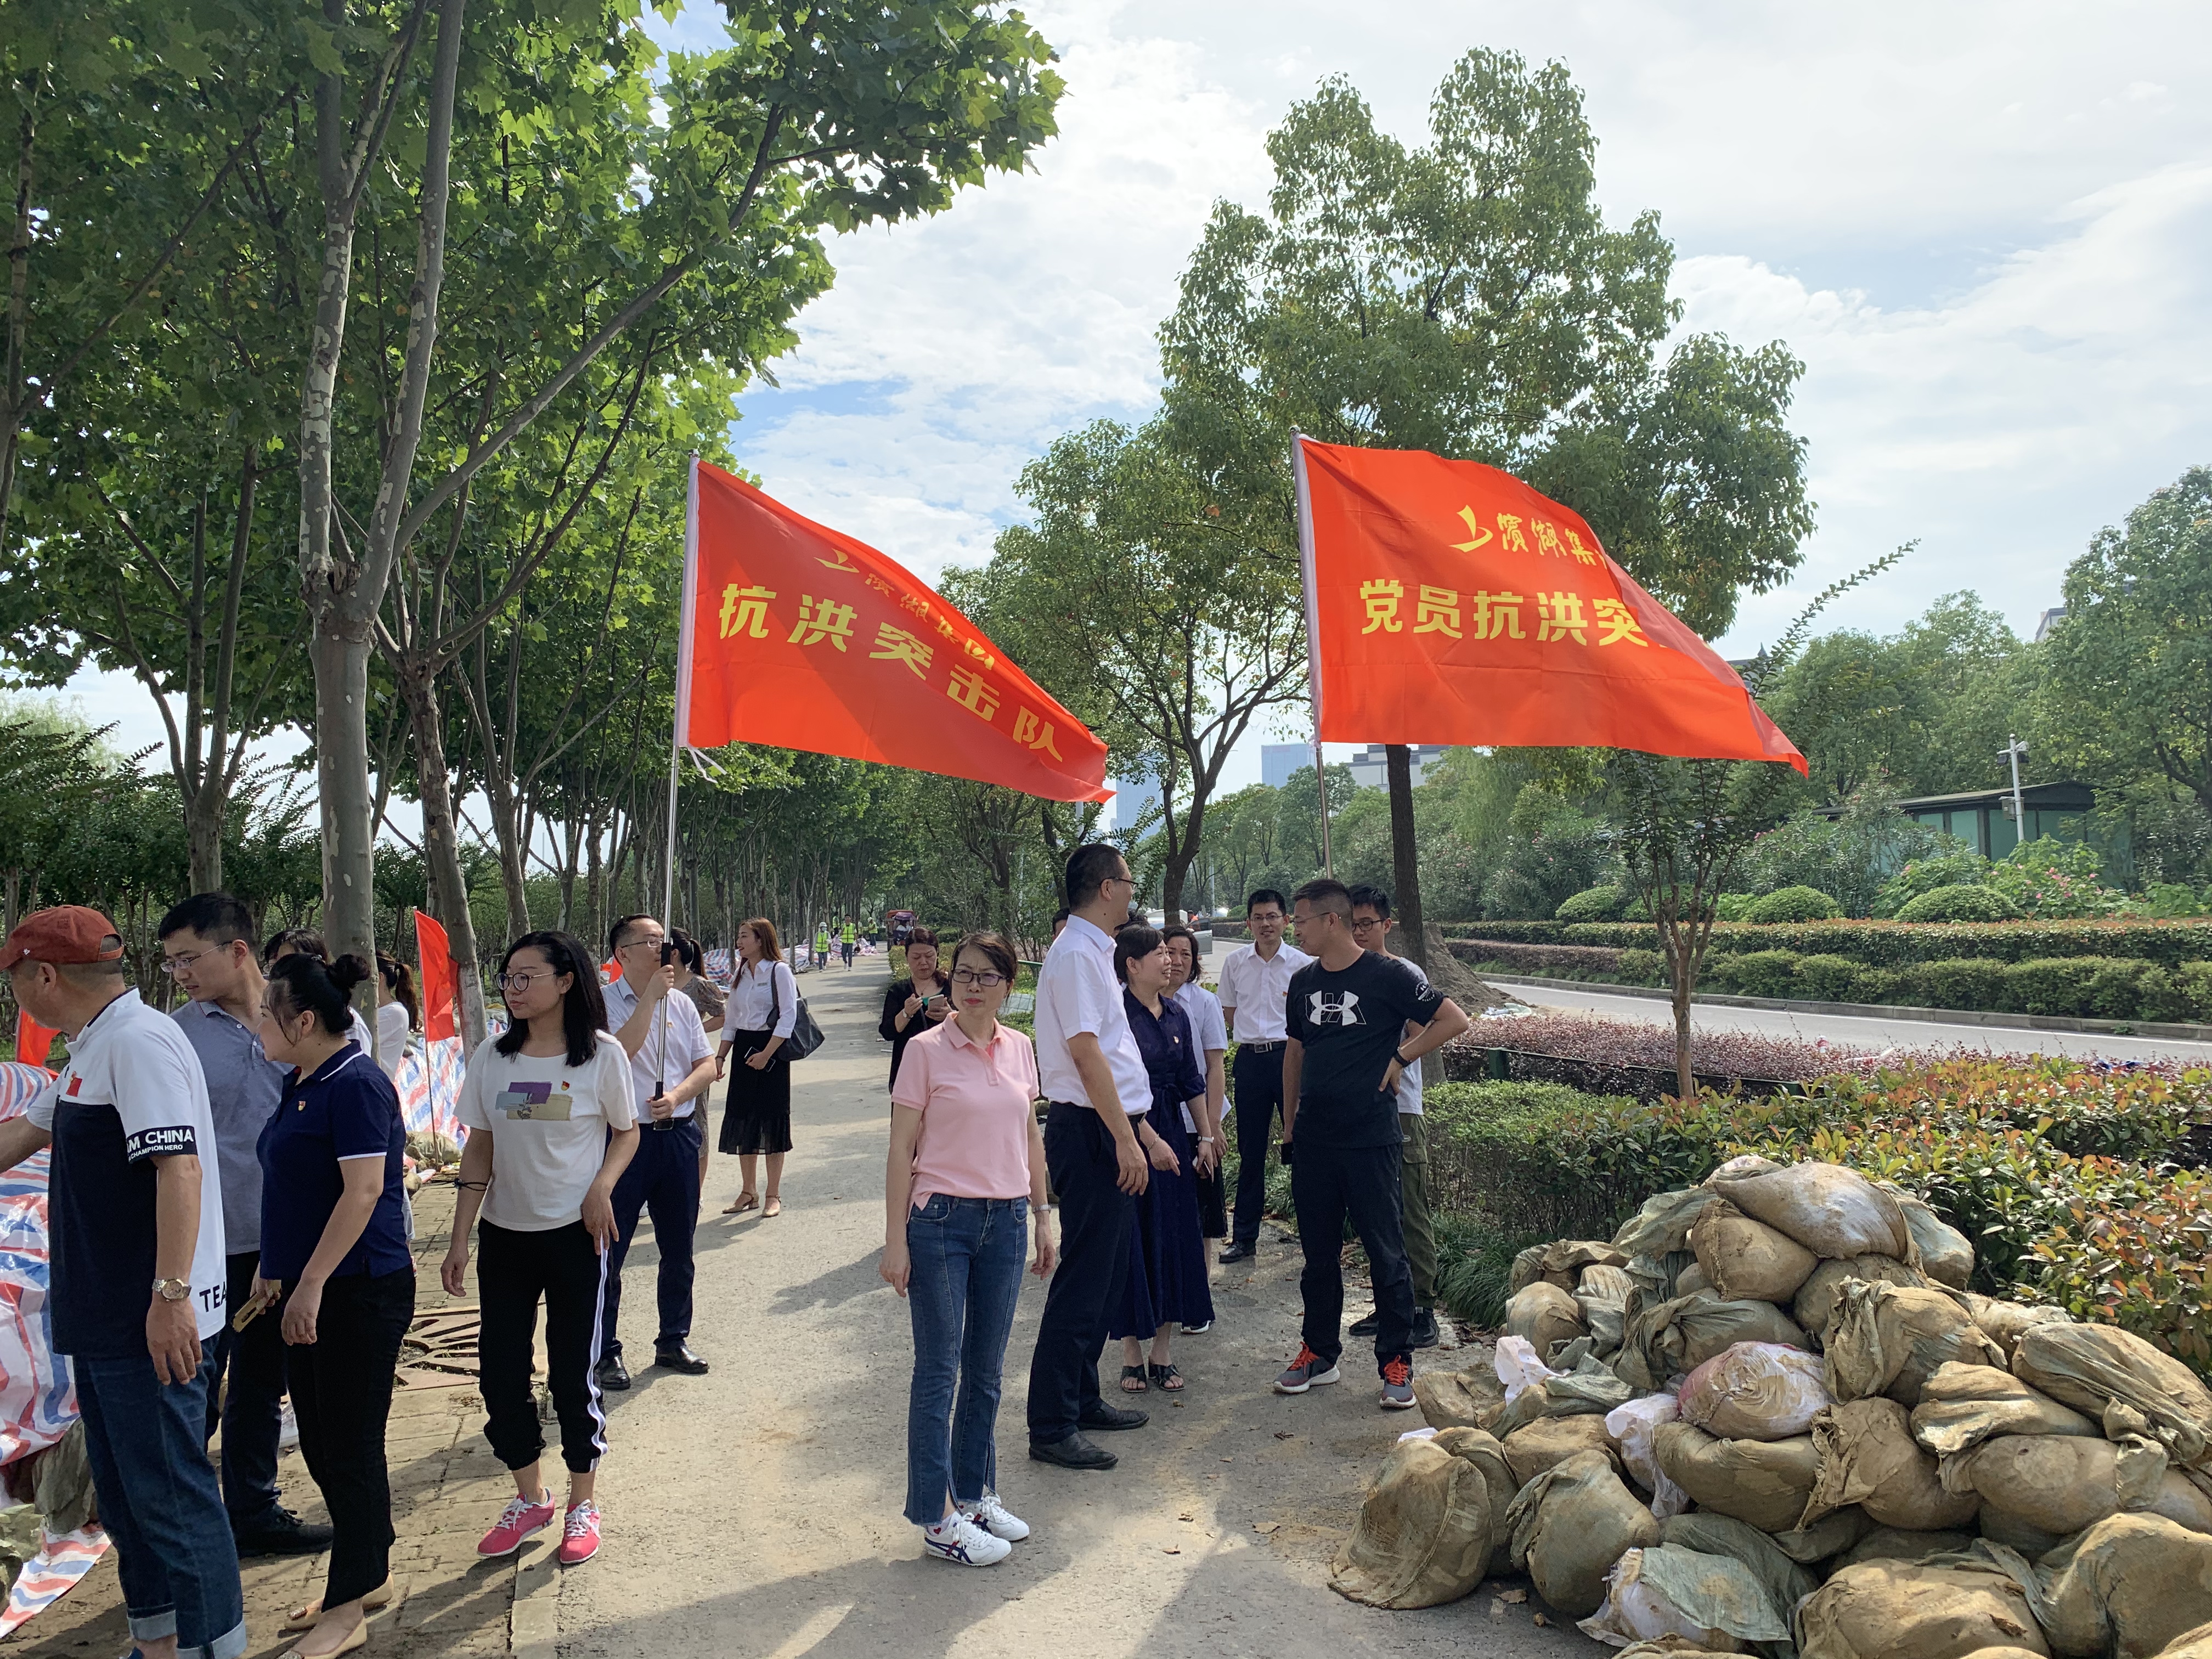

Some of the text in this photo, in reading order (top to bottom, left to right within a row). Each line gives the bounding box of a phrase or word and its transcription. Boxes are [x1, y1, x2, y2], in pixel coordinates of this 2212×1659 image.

[1359, 579, 1668, 648] 党员抗洪突
[719, 583, 1063, 763] 抗洪突击队
[127, 1128, 194, 1154] M CHINA
[131, 1144, 164, 1159] CHAMPION
